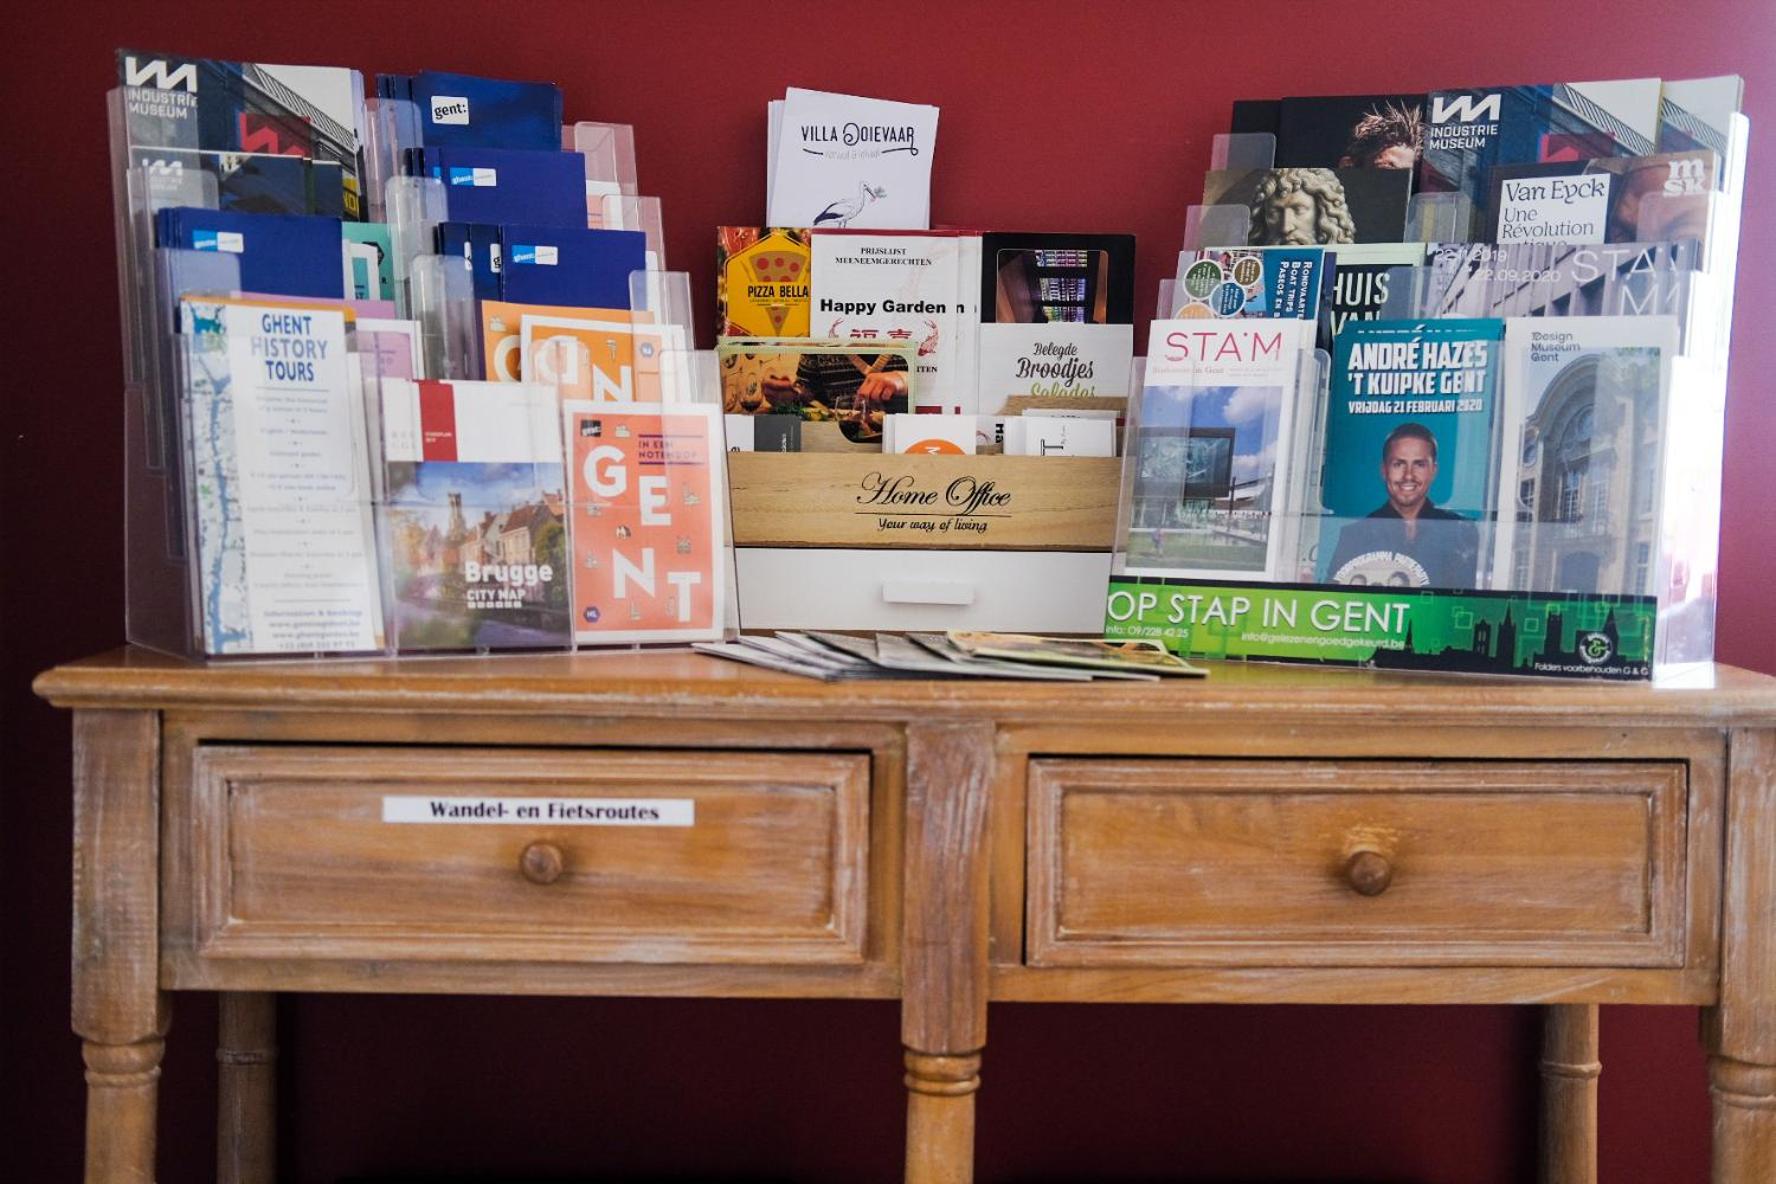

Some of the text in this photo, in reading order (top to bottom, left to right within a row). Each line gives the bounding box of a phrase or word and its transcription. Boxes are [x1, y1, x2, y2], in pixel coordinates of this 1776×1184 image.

[129, 103, 187, 119] MUSEUM
[434, 103, 466, 120] gent:
[801, 126, 838, 141] VILLA
[843, 122, 919, 156] OOIEVAAR
[1430, 124, 1498, 138] INDUSTRIE
[1429, 137, 1485, 150] MUSEUM
[1506, 178, 1605, 204] Van Eyck
[1504, 208, 1538, 223] Une
[1502, 221, 1594, 239] Révolution
[835, 256, 933, 266] MEENEEMGERECHTEN
[748, 285, 809, 298] PIZZA BELLA
[820, 299, 877, 315] Happy
[882, 300, 947, 314] Garden
[262, 313, 311, 335] GHENT
[252, 336, 328, 360] HISTORY
[1033, 341, 1078, 360] Belegde
[1348, 336, 1488, 370] ANDRÉ HAZES
[265, 361, 315, 382] TOURS
[1015, 356, 1094, 387] Broodjes
[1367, 372, 1436, 395] KUIPKE
[1440, 370, 1487, 394] GENT
[1349, 398, 1483, 414] VRIJDAG 21 FEBRUARI 2020
[856, 471, 1012, 516] Home Office
[877, 517, 988, 534] Your way of living
[465, 560, 553, 587] Brugge
[467, 589, 526, 601] CITY MAP
[1107, 590, 1410, 634] OP STAP IN GENT
[1534, 662, 1562, 672] Folders
[1563, 664, 1622, 674] voorbehouden
[1623, 667, 1631, 675] G
[430, 801, 660, 820] Wandel- en Fietsroutes
